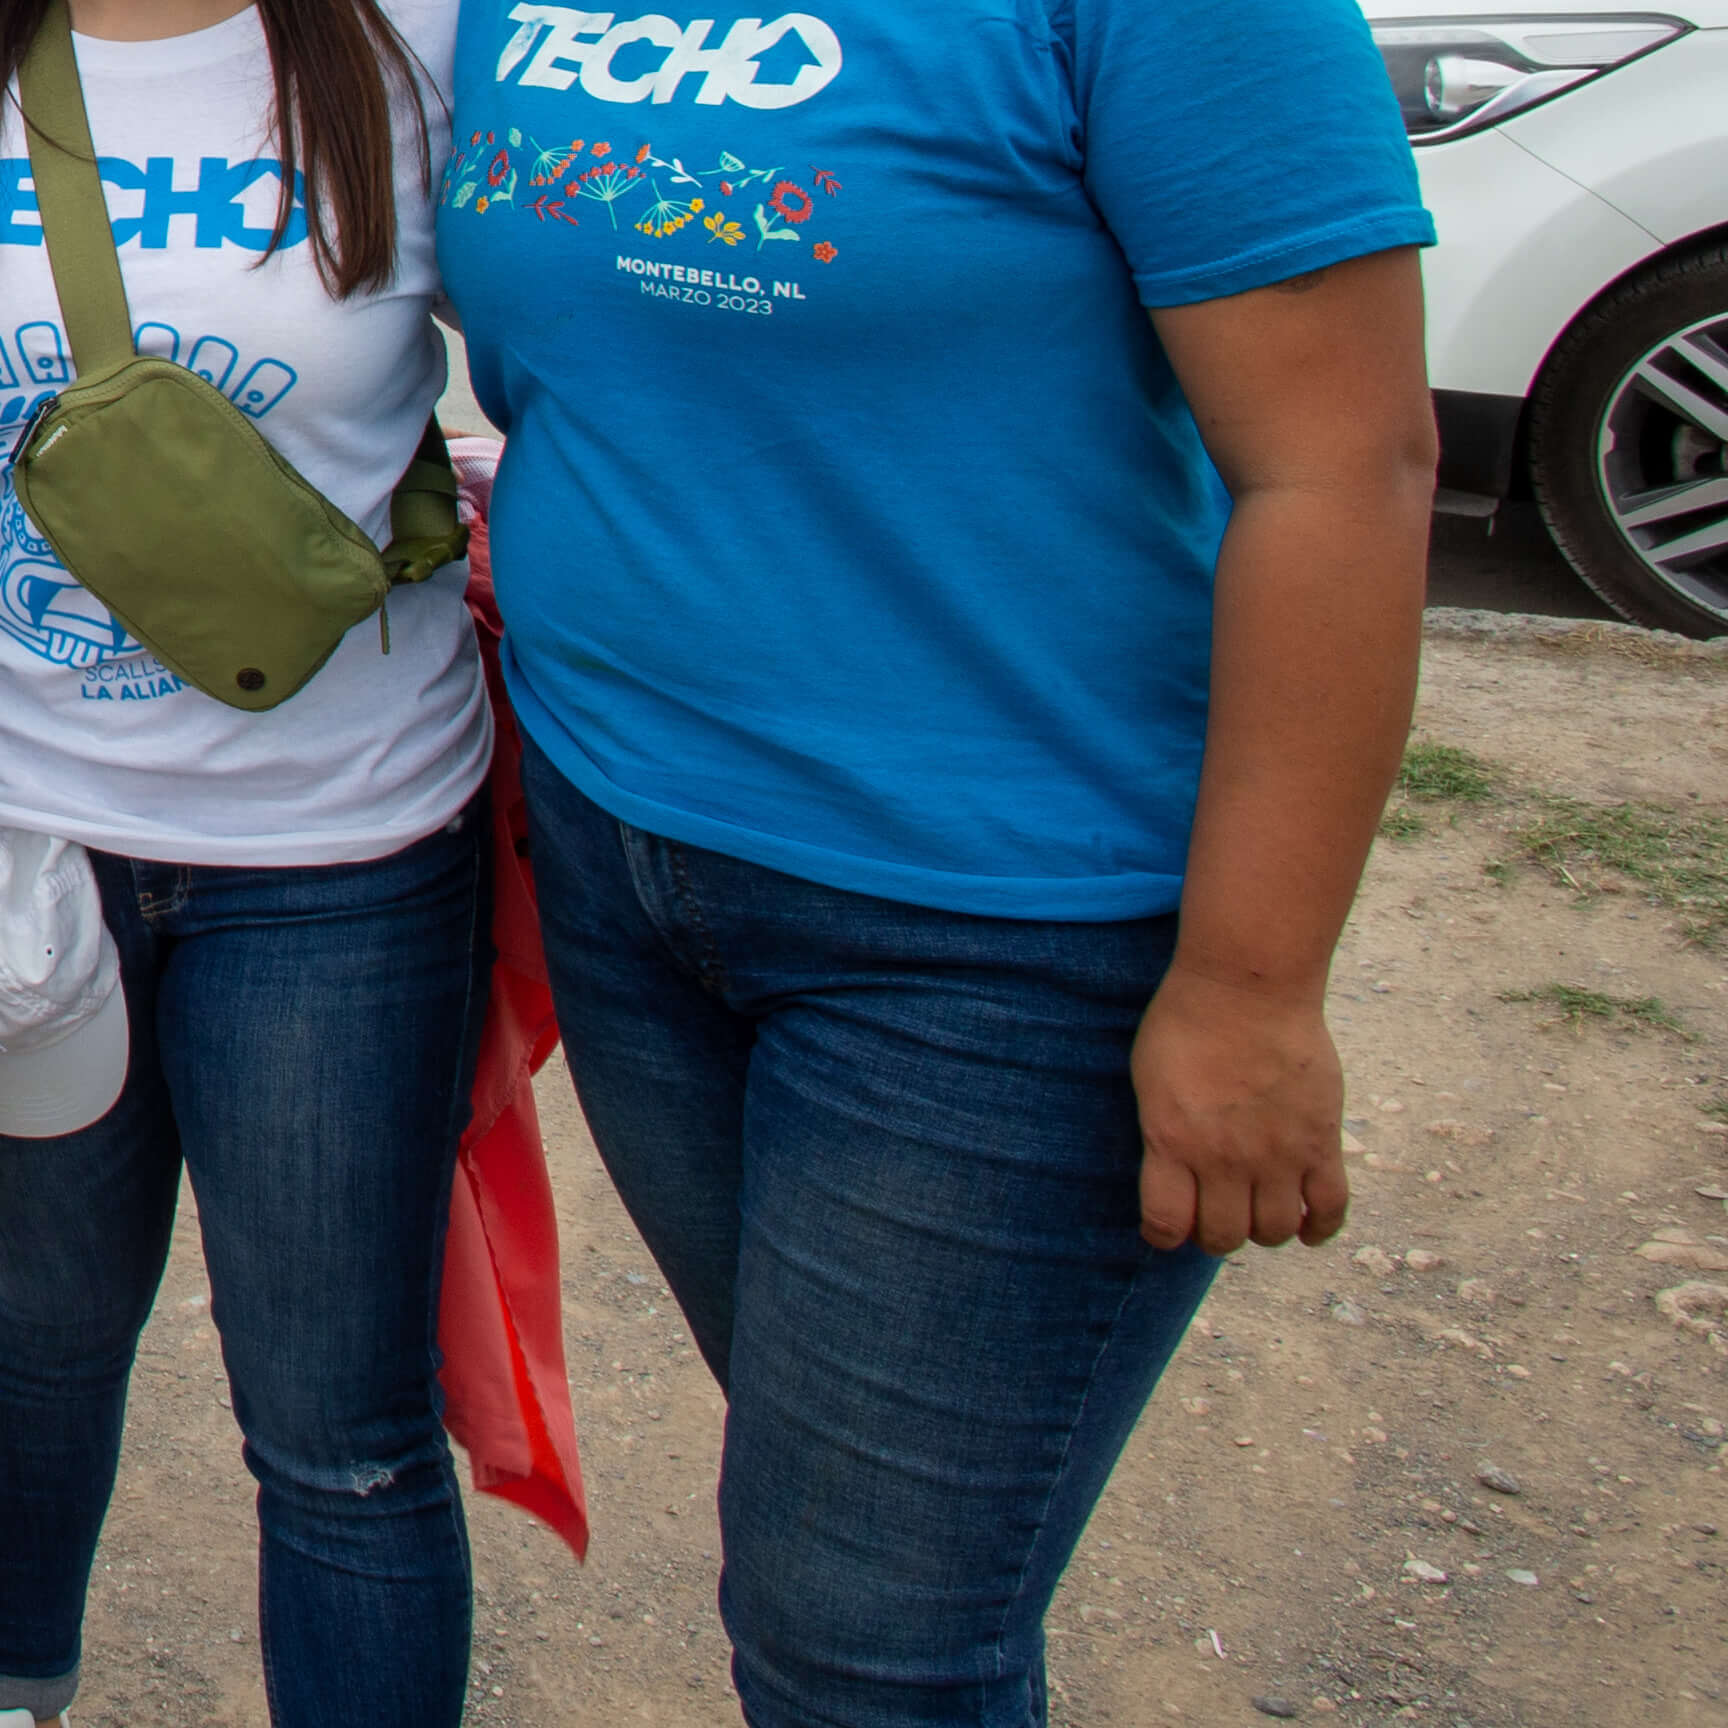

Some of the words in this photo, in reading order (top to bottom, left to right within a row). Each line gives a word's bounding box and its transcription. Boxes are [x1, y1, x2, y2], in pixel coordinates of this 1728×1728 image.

[496, 2, 842, 110] TECHO
[616, 255, 766, 296] MONTEBELLO,
[773, 281, 806, 299] NL
[640, 280, 711, 306] MARZO
[716, 293, 773, 315] 2023
[81, 683, 113, 700] LA
